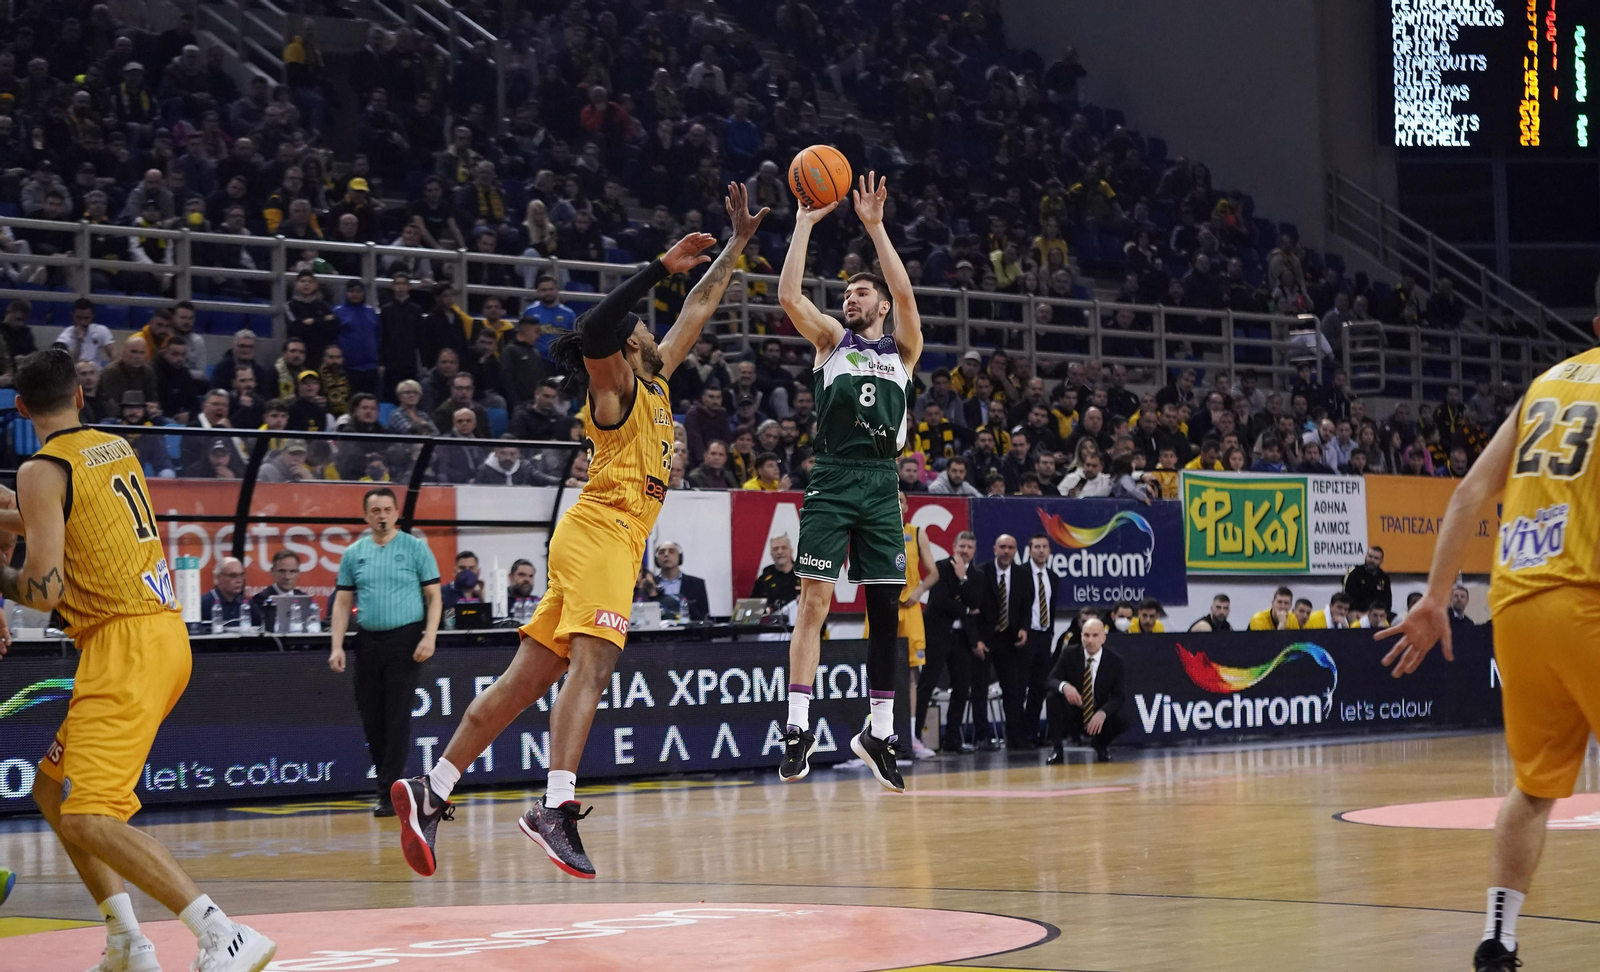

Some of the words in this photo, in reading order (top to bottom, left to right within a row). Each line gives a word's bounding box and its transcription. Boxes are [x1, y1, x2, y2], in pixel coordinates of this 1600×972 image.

[1392, 25, 1459, 41] FLIONIS
[1393, 39, 1450, 56] ORIOLA
[1552, 56, 1557, 71] 1
[1394, 84, 1470, 101] GONTIKAS
[1554, 85, 1559, 101] 1
[1519, 100, 1540, 115] 20
[1395, 129, 1470, 146] MITCHELL
[859, 383, 876, 407] 8
[1512, 398, 1599, 481] 23
[1312, 480, 1360, 495] ΠΕΡΙΣΤΕΡΙ
[111, 472, 158, 543] 11
[1314, 501, 1347, 514] ΑΘΗΝΑ
[1314, 521, 1350, 535] ΑΛΙΜΟΣ
[1380, 515, 1434, 535] ΤΡΑΠΕΖΑ
[1314, 541, 1364, 555] ΒΡΙΛΗΣΣΙΑ
[1073, 584, 1100, 602] let's
[1103, 584, 1146, 602] colour
[597, 612, 628, 634] AVIS
[1134, 692, 1322, 733] Vivechrom
[1340, 701, 1374, 721] let's
[1380, 697, 1433, 719] colour
[145, 761, 215, 791] let's
[224, 757, 336, 787] colour
